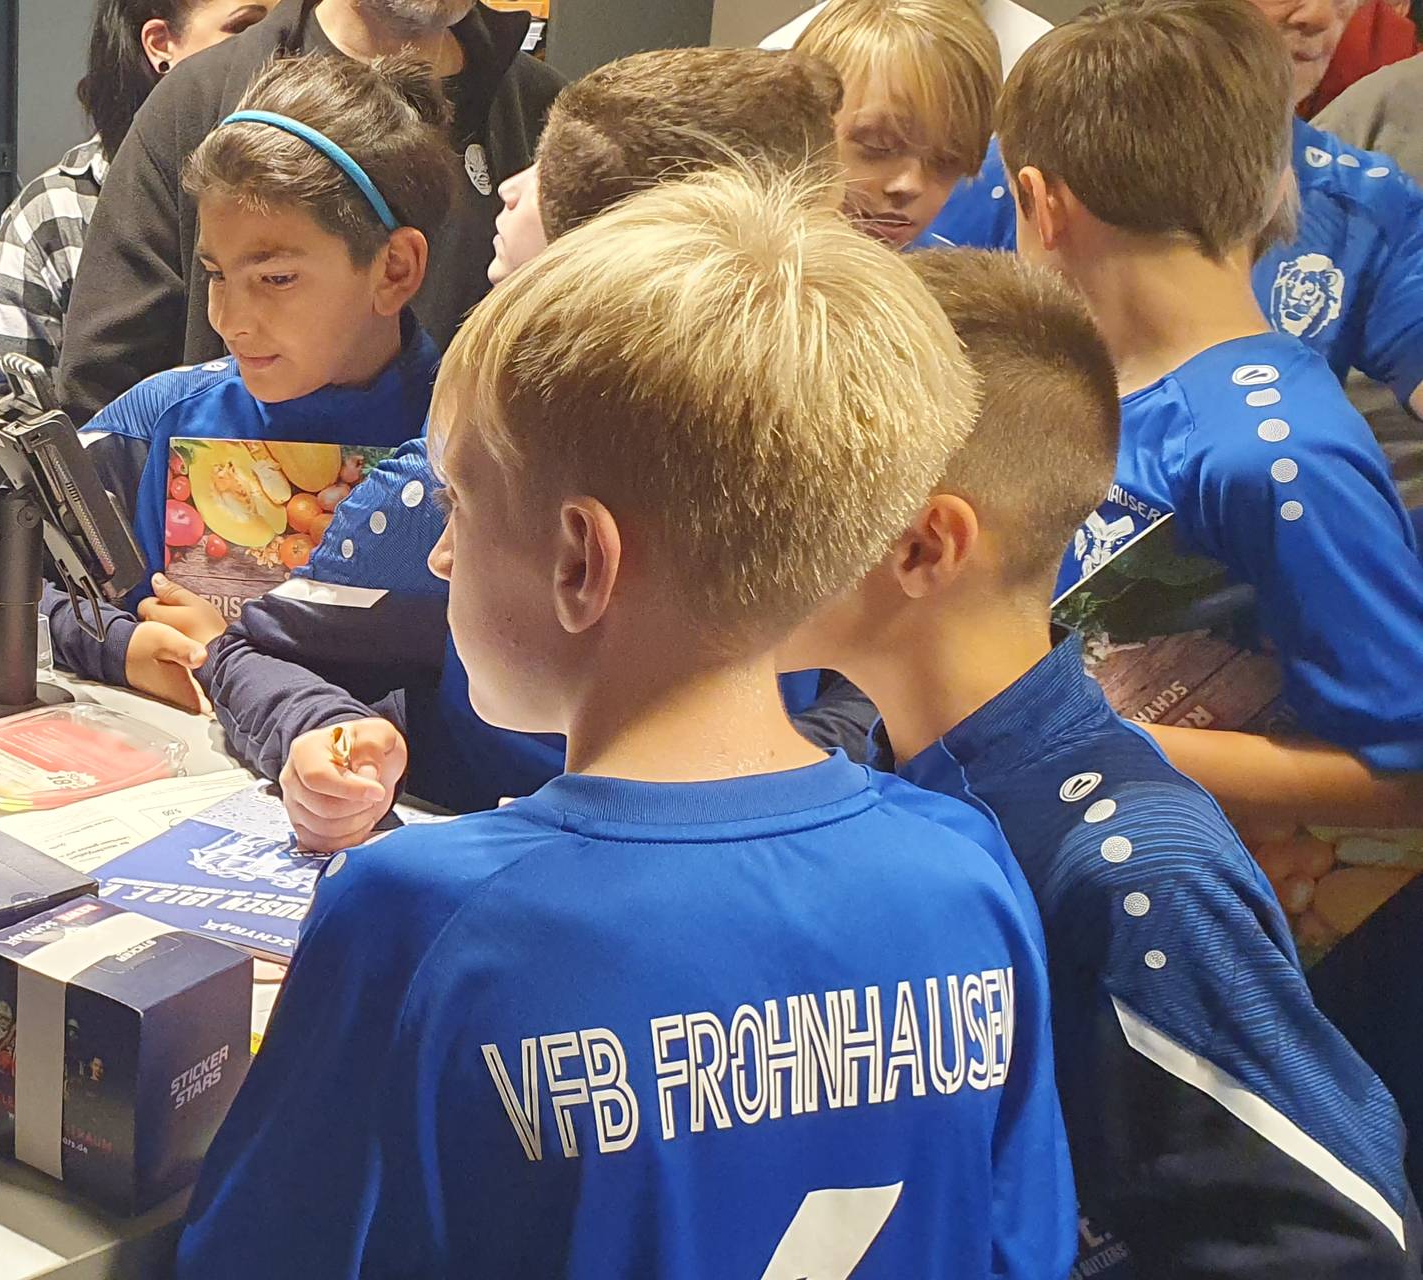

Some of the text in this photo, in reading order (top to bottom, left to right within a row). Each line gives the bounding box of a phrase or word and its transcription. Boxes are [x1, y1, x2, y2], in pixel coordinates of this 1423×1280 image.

[145, 890, 218, 908] 1912
[170, 1044, 229, 1097] STICKER
[480, 966, 1014, 1161] VFB FROHNHAUSEN
[175, 1066, 222, 1110] STARS
